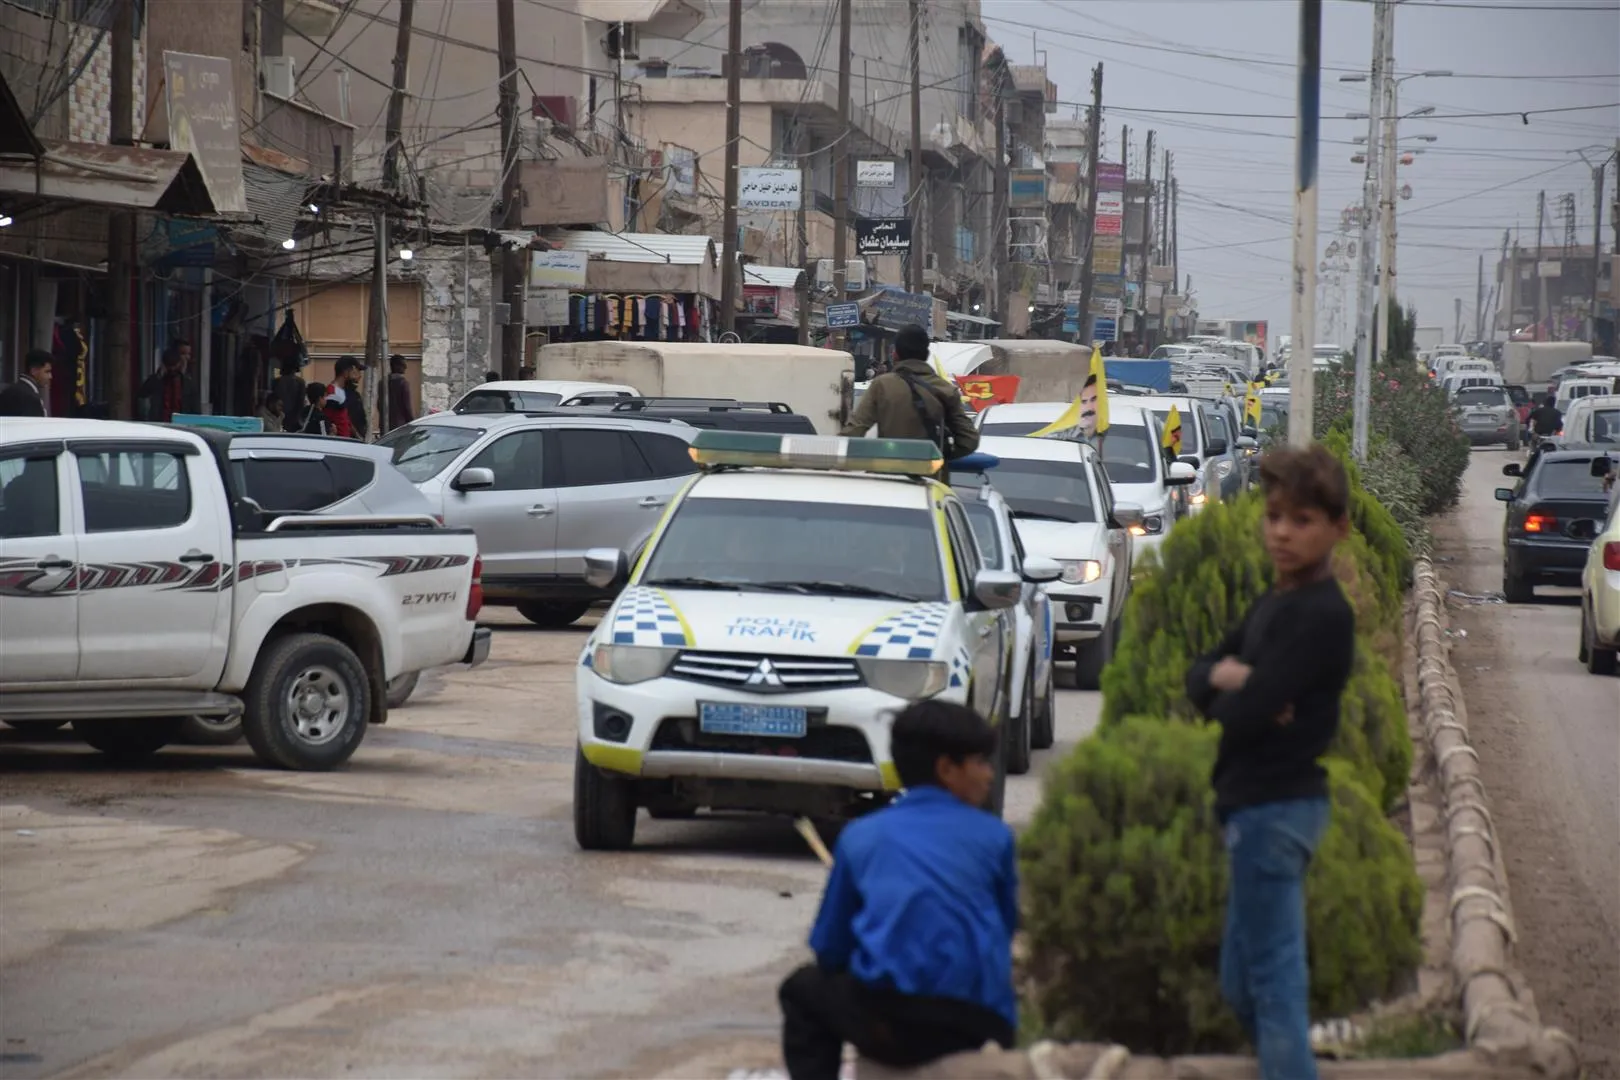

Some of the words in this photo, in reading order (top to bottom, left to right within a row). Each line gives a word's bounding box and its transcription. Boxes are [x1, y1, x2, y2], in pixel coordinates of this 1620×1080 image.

[872, 222, 896, 234] المحامي
[859, 234, 880, 249] عثمان
[880, 234, 910, 249] سليمان
